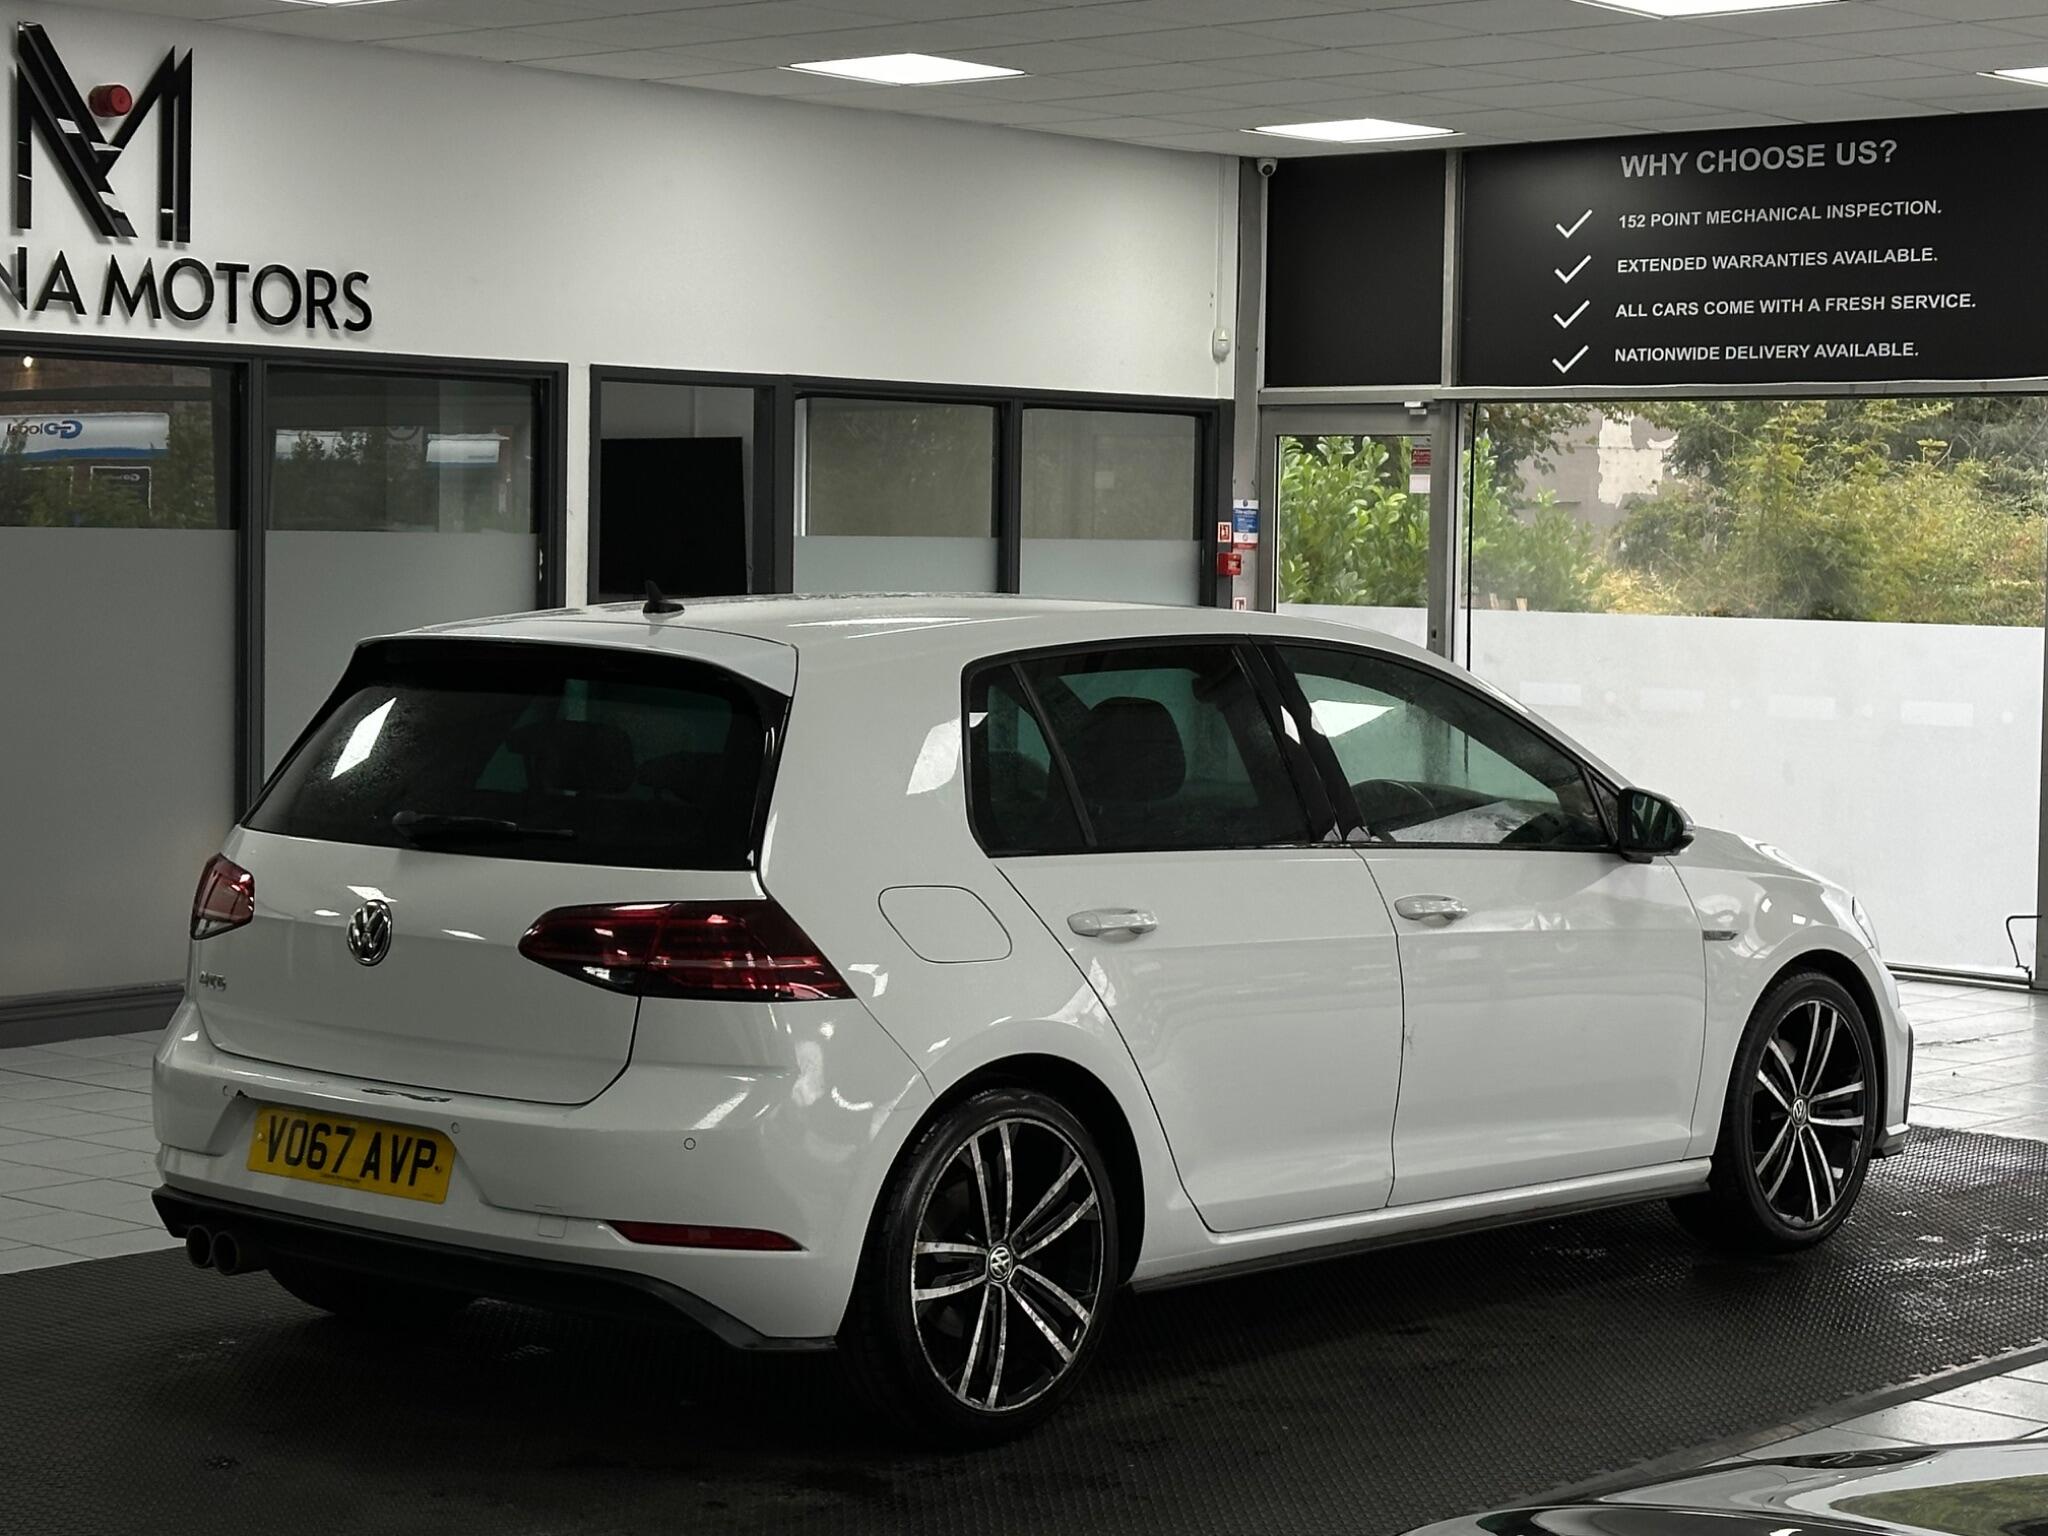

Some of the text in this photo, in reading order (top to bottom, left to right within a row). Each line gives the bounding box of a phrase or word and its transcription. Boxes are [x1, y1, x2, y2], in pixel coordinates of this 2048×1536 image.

[1620, 139, 1898, 178] WHY CHOOSE US?
[1618, 199, 1943, 229] 152 POINT MECHANICAL INSPECTION.
[1617, 247, 1939, 274] EXTENDED WARRANTIES AVAILABLE.
[101, 253, 373, 332] MOTORS
[1615, 293, 1977, 318] ALL CARS COME WITH A FRESH SERVICE.
[1615, 341, 1920, 362] NATIONWIDE DELIVERY AVAILABLE.
[267, 1115, 437, 1187] VO67 AVP
